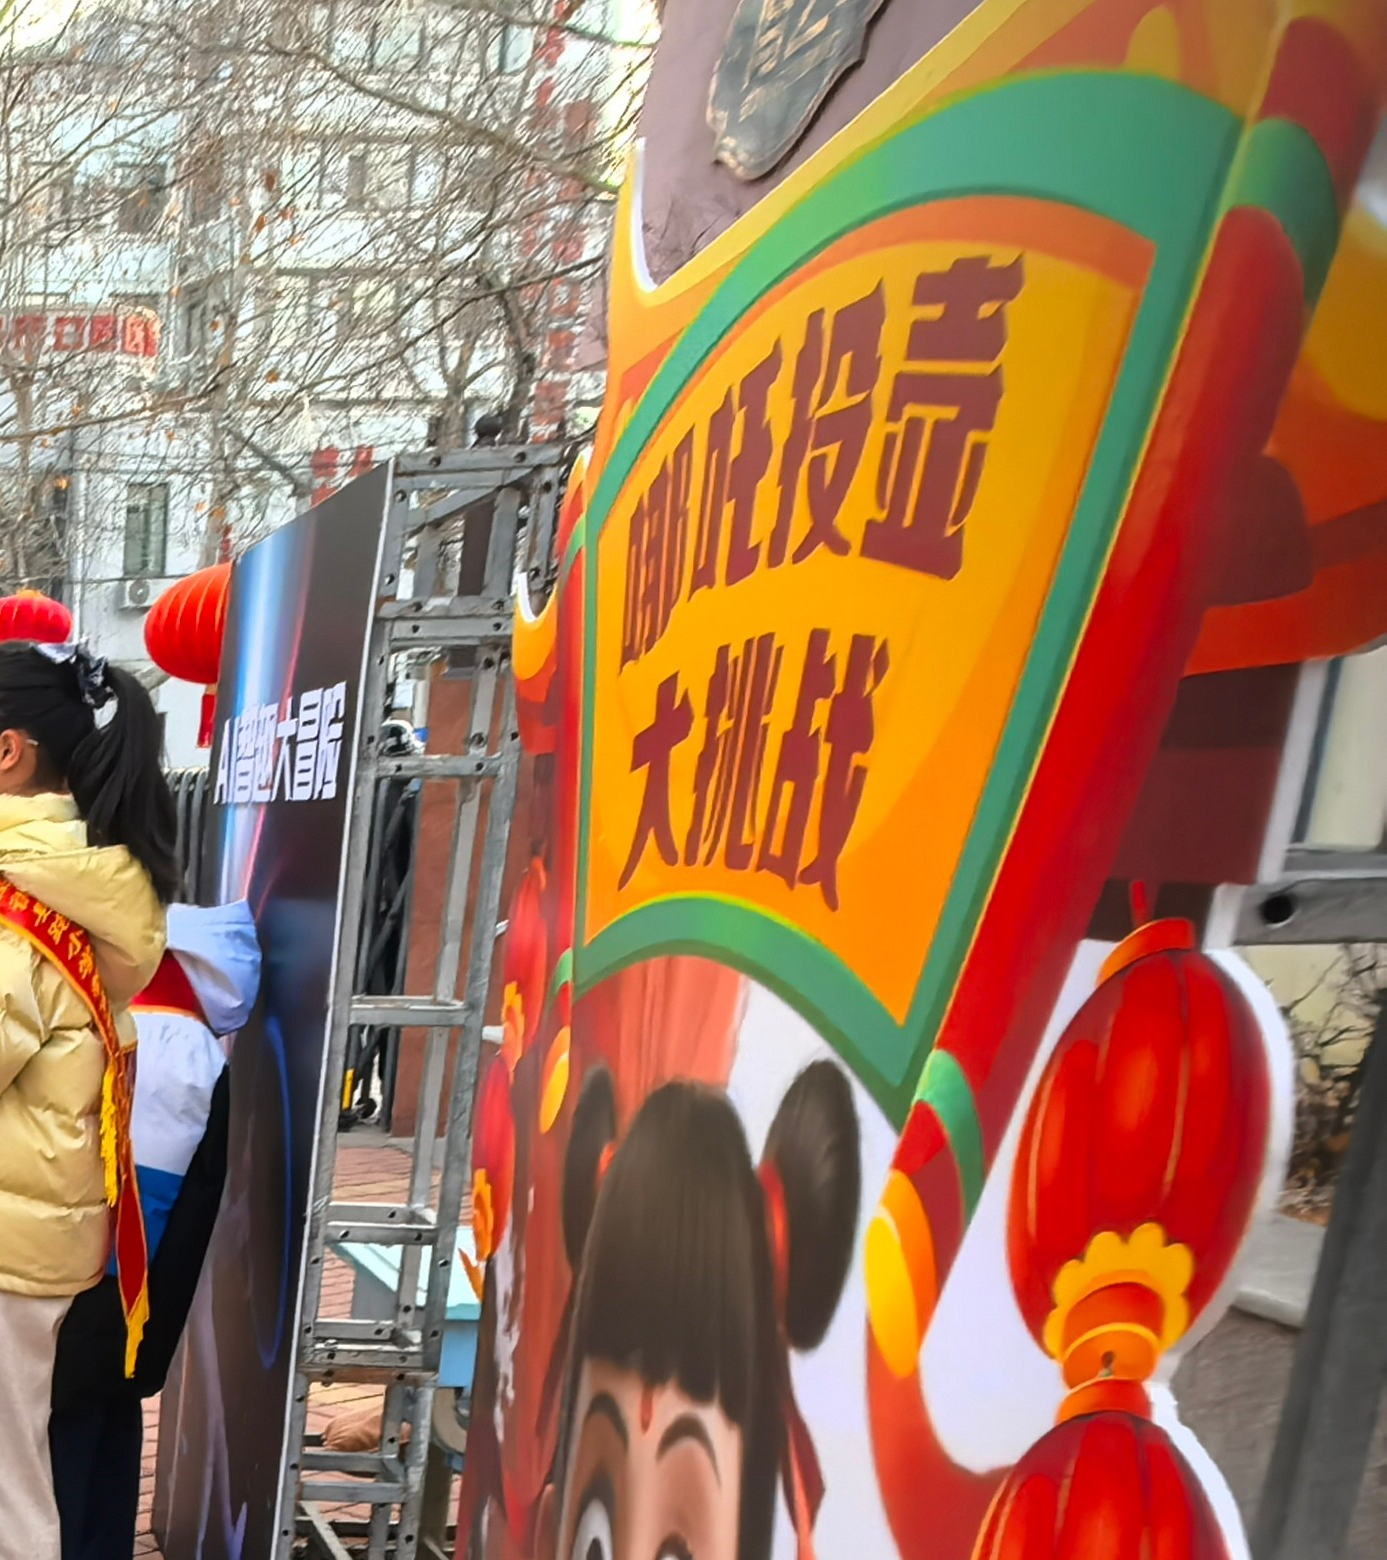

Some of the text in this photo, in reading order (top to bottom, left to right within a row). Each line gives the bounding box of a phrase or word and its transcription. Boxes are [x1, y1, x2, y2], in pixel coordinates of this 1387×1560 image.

[620, 253, 1025, 676] 哪吒投壶
[618, 627, 891, 912] 大挑战
